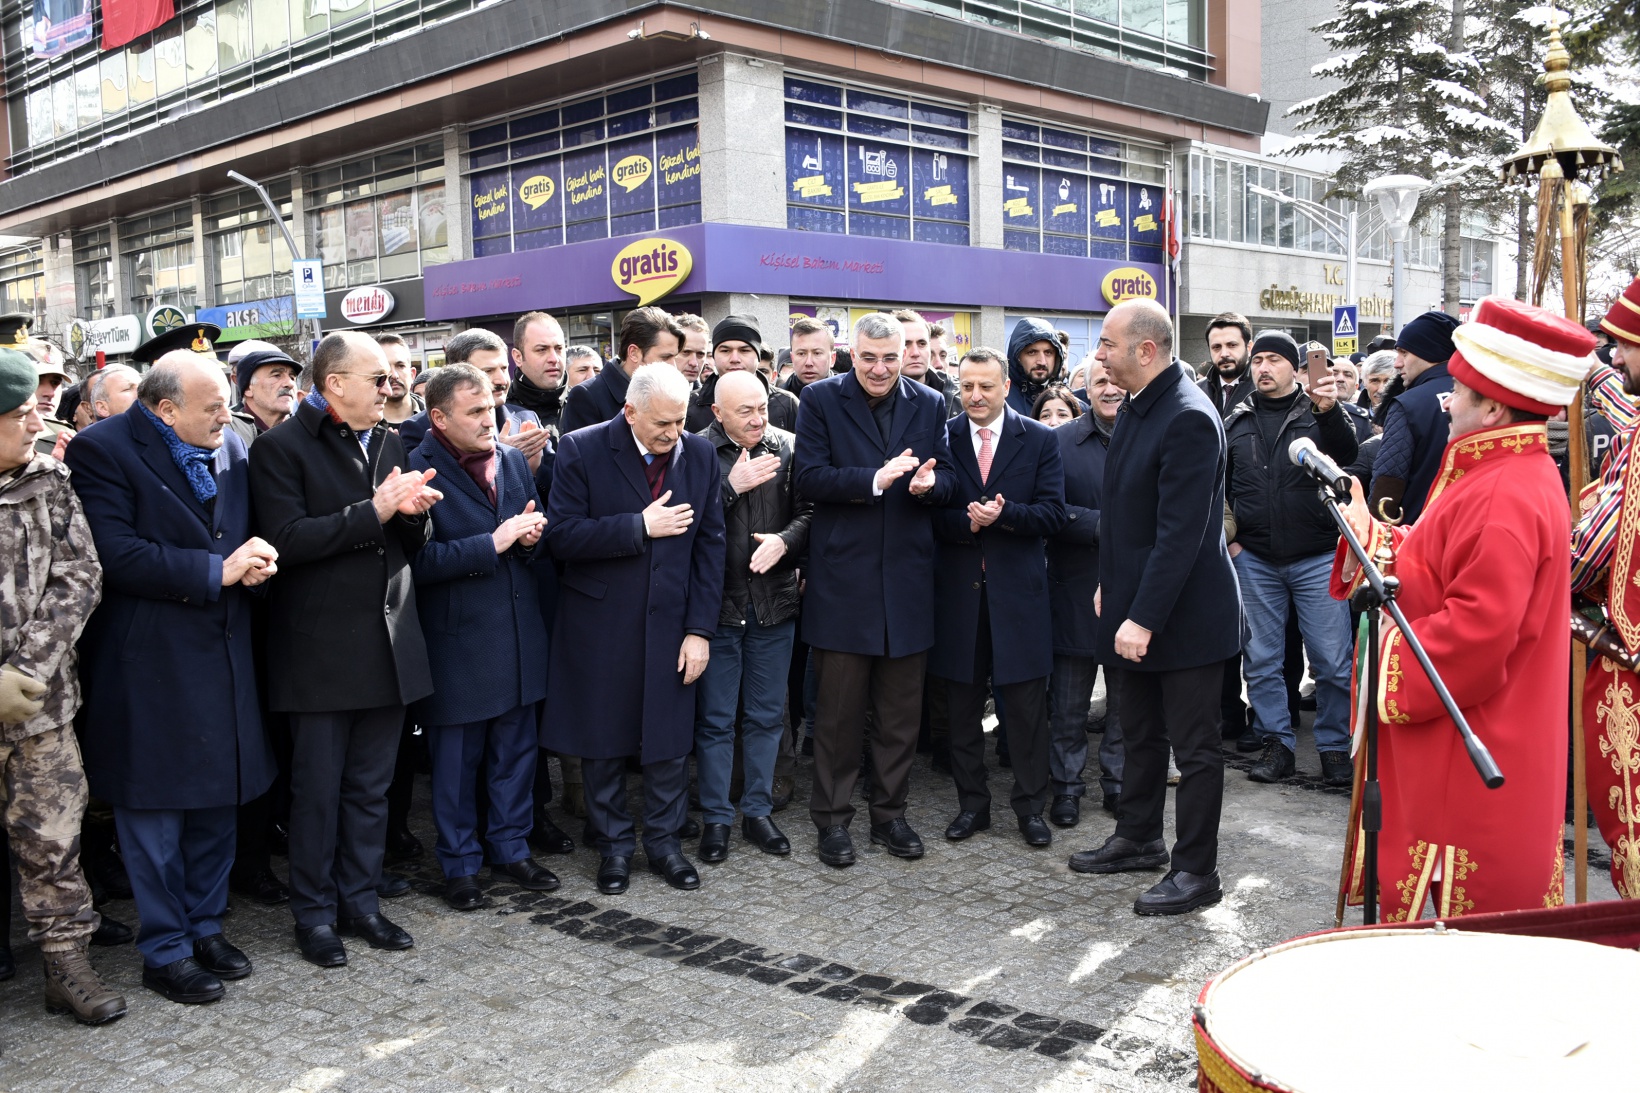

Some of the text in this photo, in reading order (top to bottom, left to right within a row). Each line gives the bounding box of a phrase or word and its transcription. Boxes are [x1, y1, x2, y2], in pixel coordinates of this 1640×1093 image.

[617, 158, 647, 181] gratis
[659, 149, 685, 171] Güzel
[566, 165, 605, 192] Güzel bak
[665, 164, 700, 185] kendine
[474, 184, 508, 208] Güzel bak
[524, 179, 551, 200] gratis
[571, 186, 602, 205] kendine
[478, 203, 505, 220] kendine
[619, 244, 678, 285] gratis
[760, 252, 885, 274] Kişisel Bakım Marketi
[1111, 273, 1152, 298] gratis
[1323, 264, 1345, 286] T.C.
[346, 289, 385, 315] mendy
[227, 308, 259, 328] aksa
[1593, 434, 1610, 458] P
